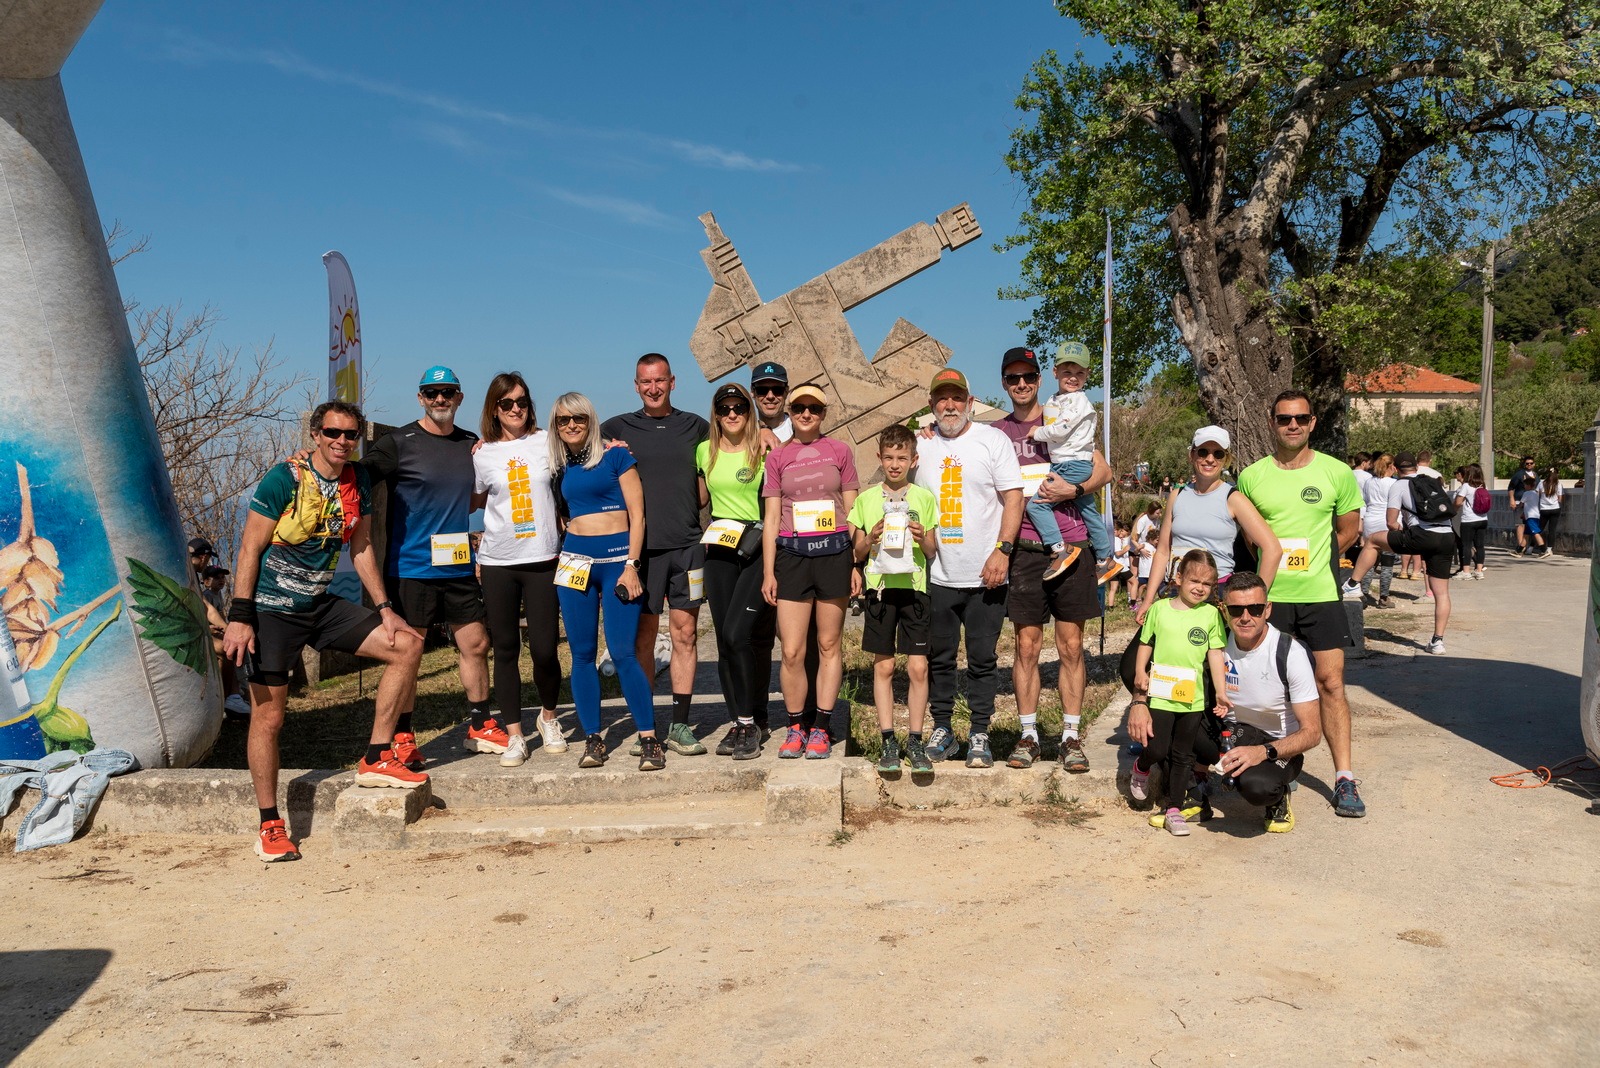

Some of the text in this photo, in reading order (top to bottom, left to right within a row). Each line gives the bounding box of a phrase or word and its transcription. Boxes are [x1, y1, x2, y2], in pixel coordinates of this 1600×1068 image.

[941, 466, 963, 483] JE
[508, 480, 531, 496] SE
[940, 482, 963, 499] SE
[511, 508, 535, 524] CE
[816, 517, 833, 527] 164
[940, 513, 963, 528] CE
[719, 533, 737, 544] 208
[453, 550, 467, 560] 161
[1288, 556, 1305, 566] 231
[570, 575, 585, 586] 128
